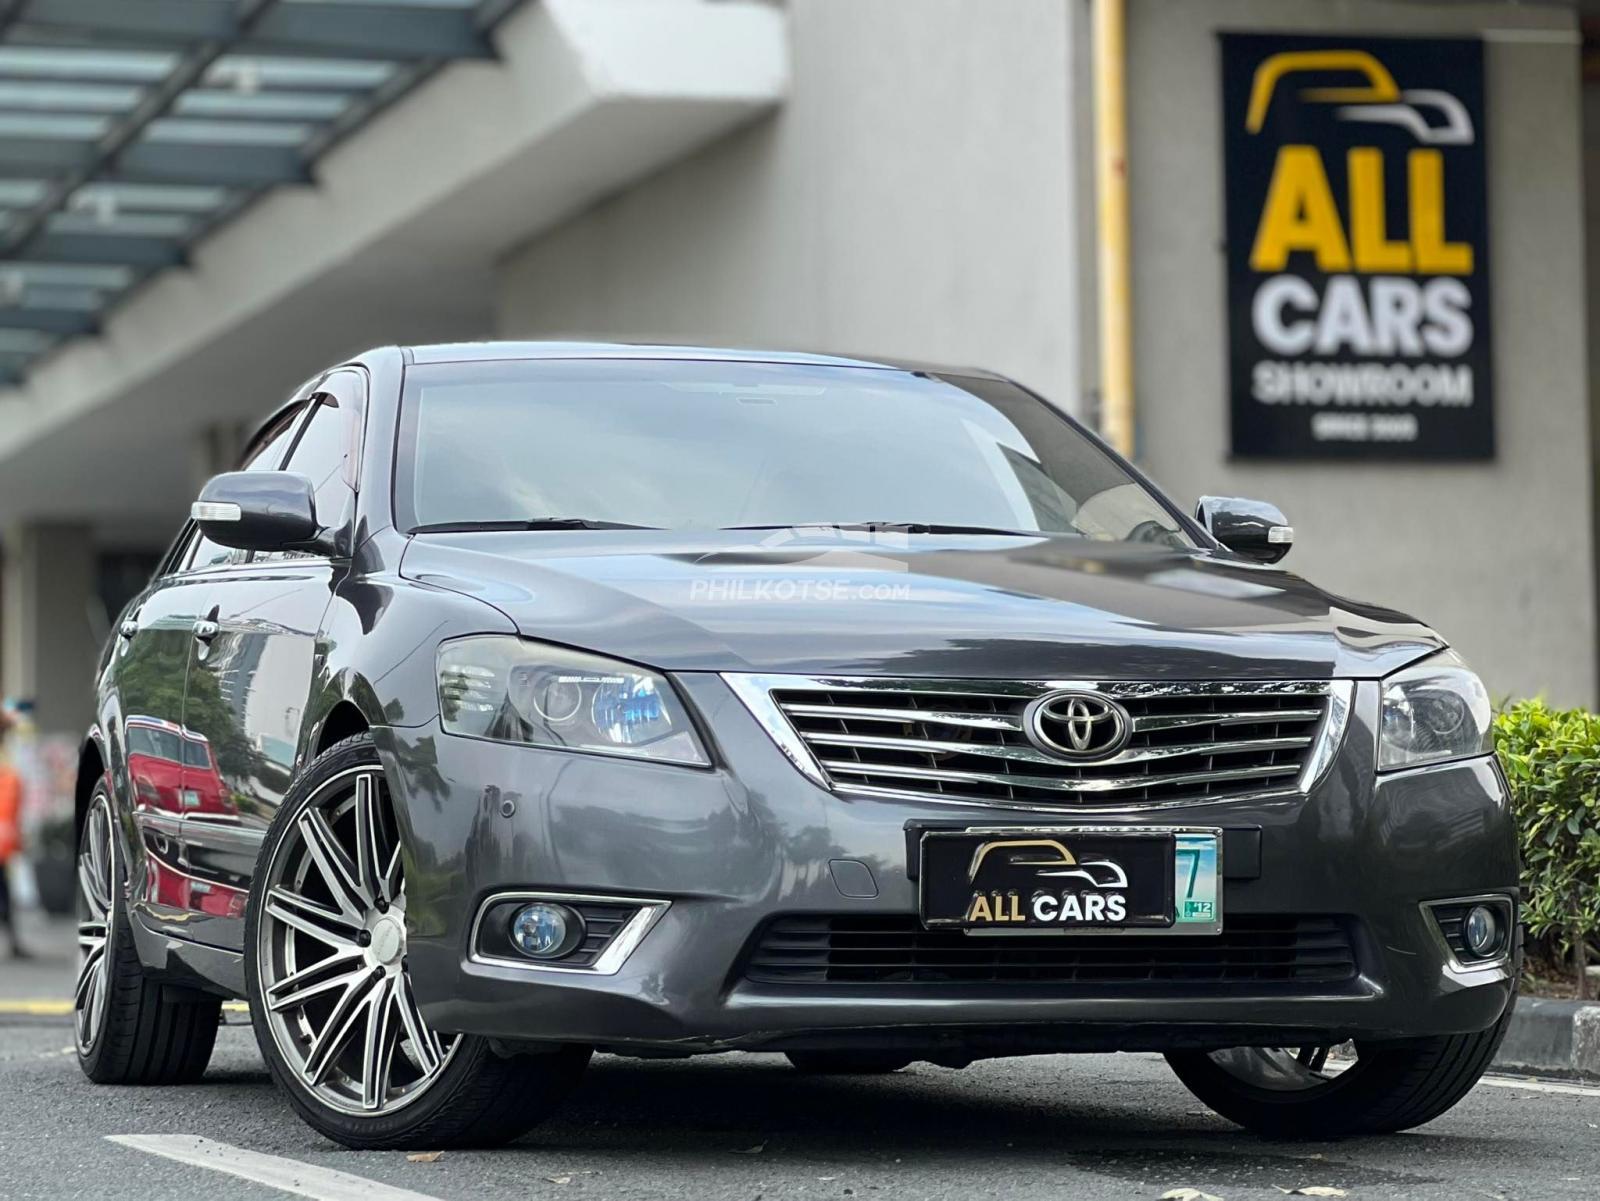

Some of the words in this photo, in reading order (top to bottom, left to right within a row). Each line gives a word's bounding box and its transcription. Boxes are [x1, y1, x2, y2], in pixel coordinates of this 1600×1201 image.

[1249, 145, 1474, 274] ALL
[1251, 275, 1474, 357] CARS
[1252, 361, 1474, 406] SHOWROOM
[969, 895, 1026, 922] ALL
[1033, 895, 1127, 922] CARS
